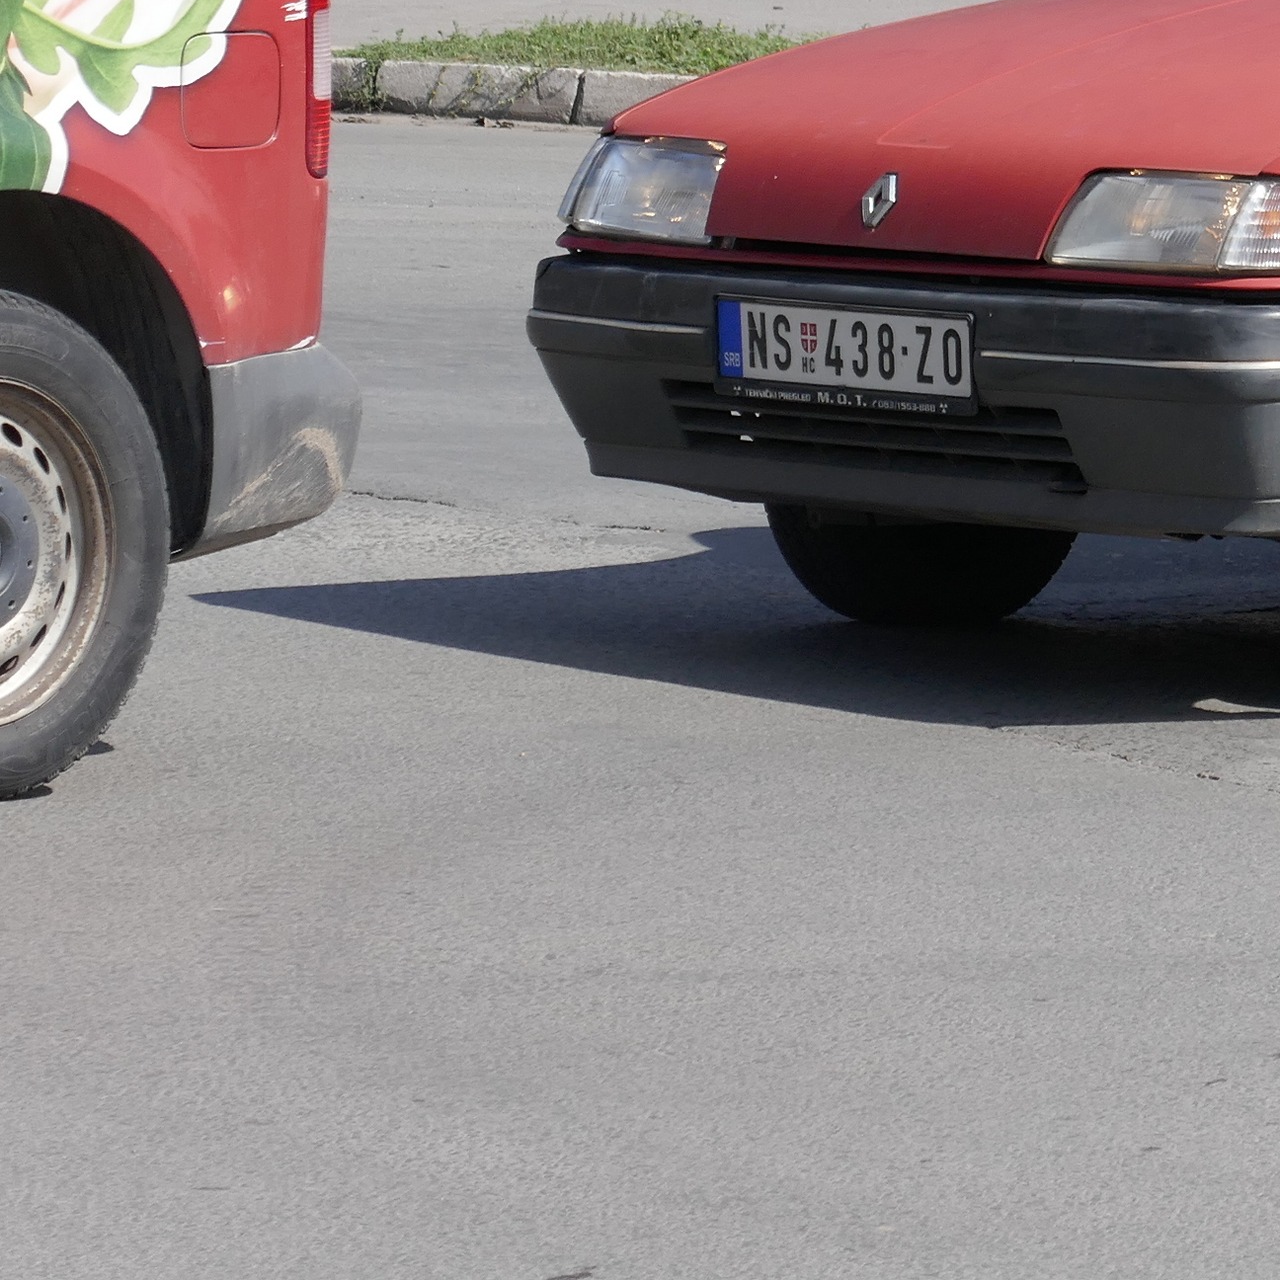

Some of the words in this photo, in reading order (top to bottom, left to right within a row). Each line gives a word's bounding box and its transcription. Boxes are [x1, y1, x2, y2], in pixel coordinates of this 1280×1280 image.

[747, 310, 792, 372] NS
[723, 351, 741, 368] SRB
[778, 390, 811, 403] PREGLED
